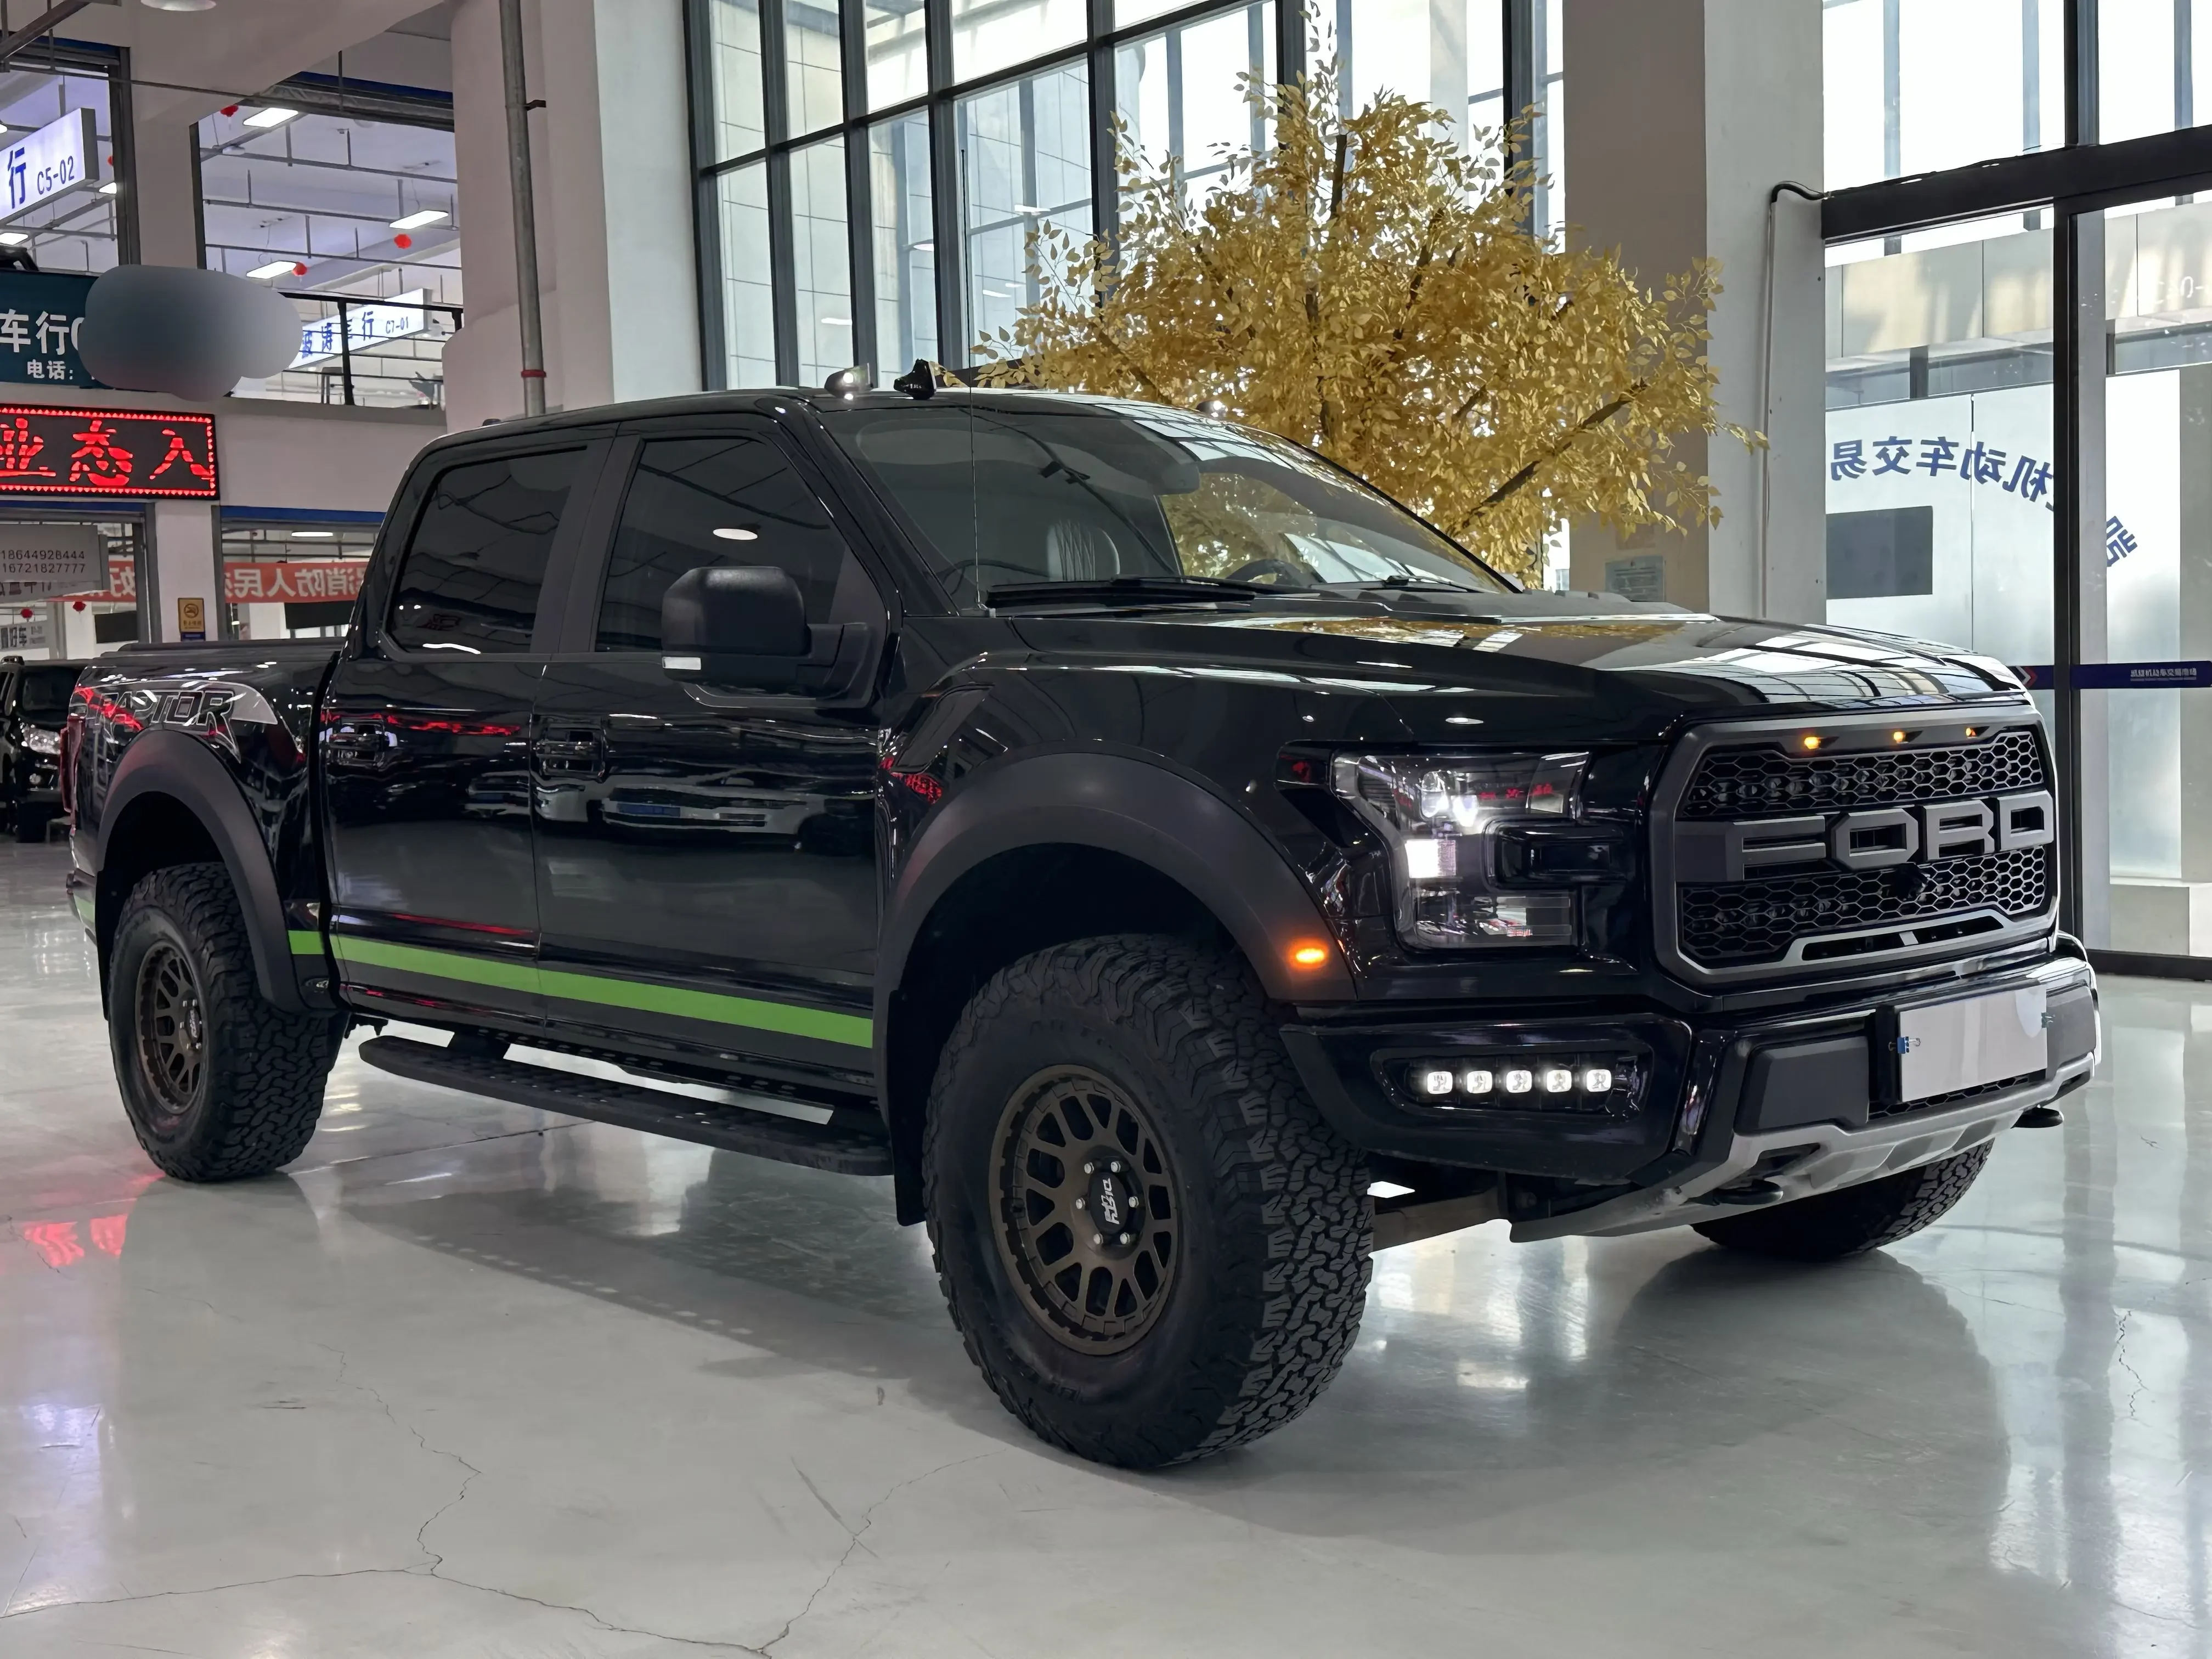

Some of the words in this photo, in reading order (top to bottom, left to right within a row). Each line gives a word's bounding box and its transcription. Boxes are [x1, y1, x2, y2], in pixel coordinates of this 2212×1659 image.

[8, 146, 26, 209] 行
[37, 155, 75, 195] C5-02
[1726, 790, 2053, 882] FORD
